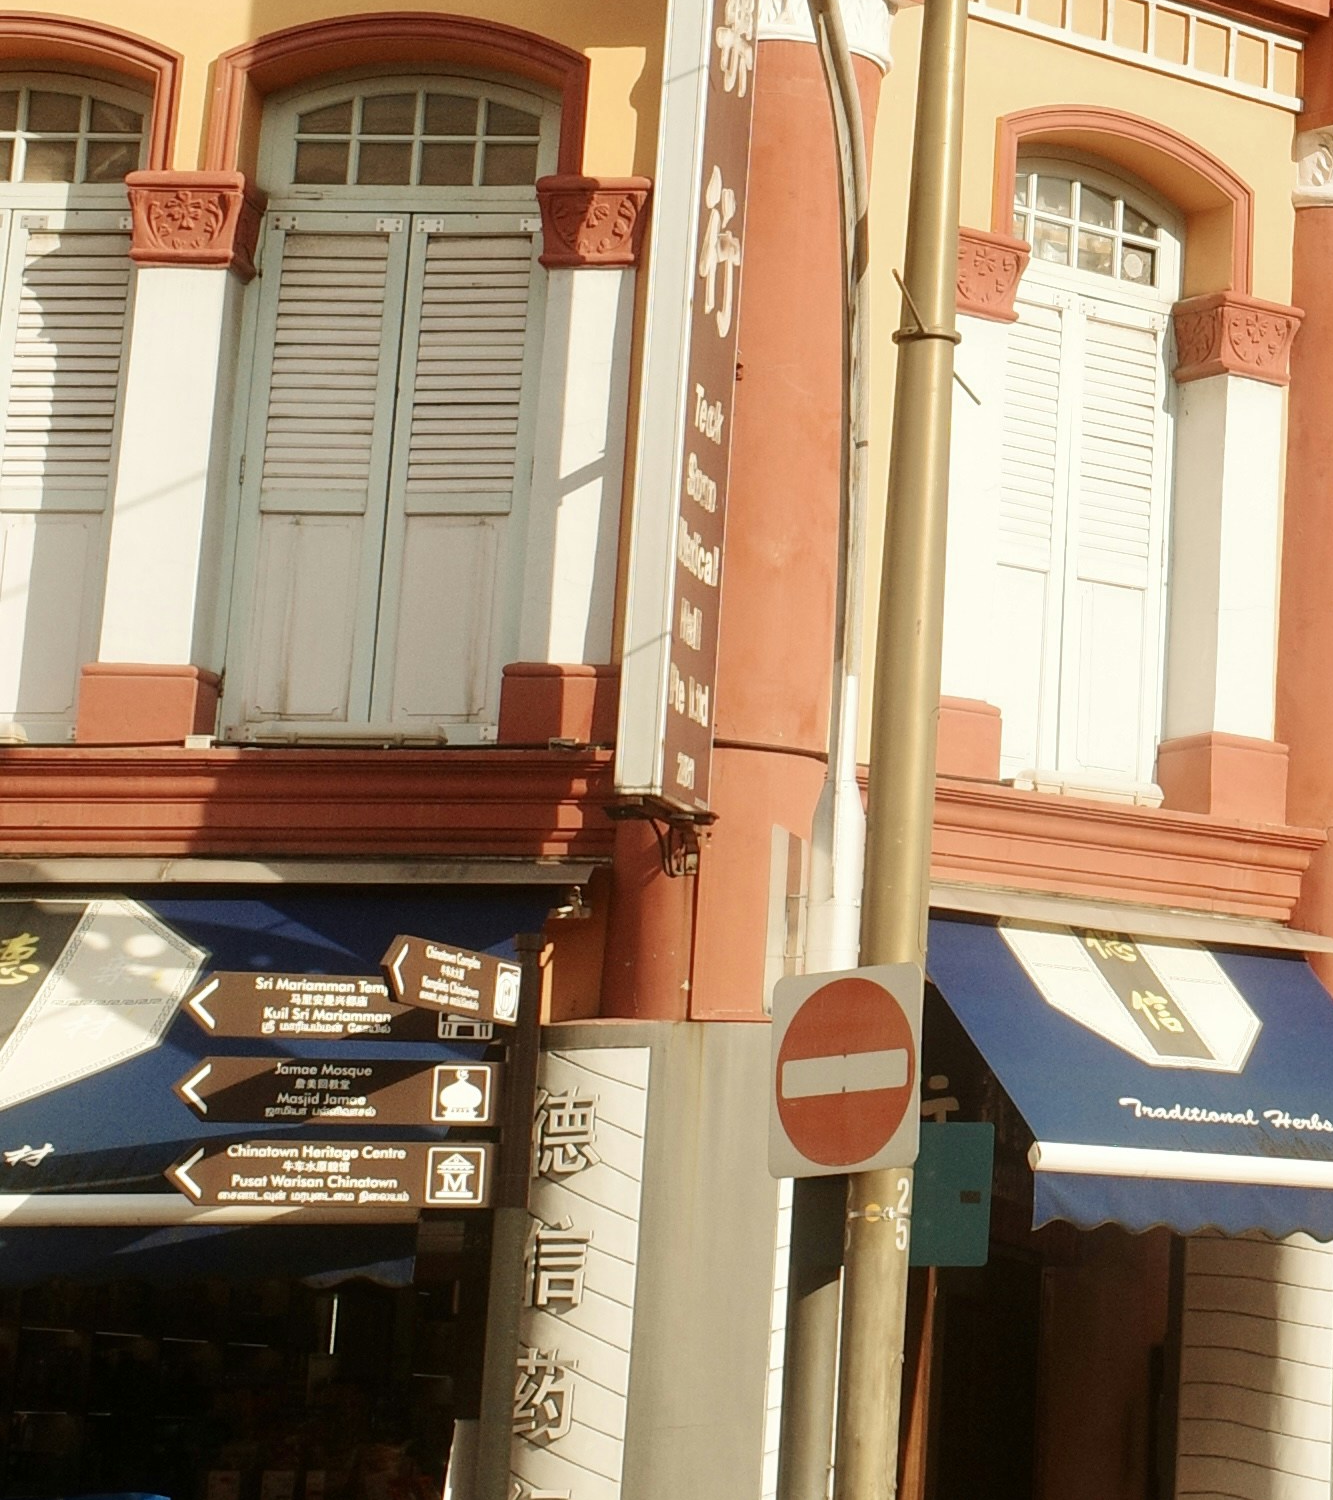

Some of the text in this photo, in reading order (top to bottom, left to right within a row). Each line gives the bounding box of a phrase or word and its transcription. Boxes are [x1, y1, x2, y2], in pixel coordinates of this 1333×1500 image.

[693, 383, 724, 444] Teck
[687, 452, 717, 512] Soon
[677, 517, 720, 587] Medical
[680, 597, 702, 651] Hall
[668, 662, 709, 728] Pte Ltd
[255, 977, 389, 996] Sri Mariamman Tem
[263, 1007, 391, 1023] Kuil Sri Mariamman
[275, 1063, 372, 1078] Jamae Mosque
[277, 1093, 367, 1107] Masjid Jamae
[1119, 1097, 1259, 1125] Traditional
[227, 1144, 407, 1161] Chinatown Heritage Centre
[231, 1174, 398, 1188] Pusat Warisan Chinatown
